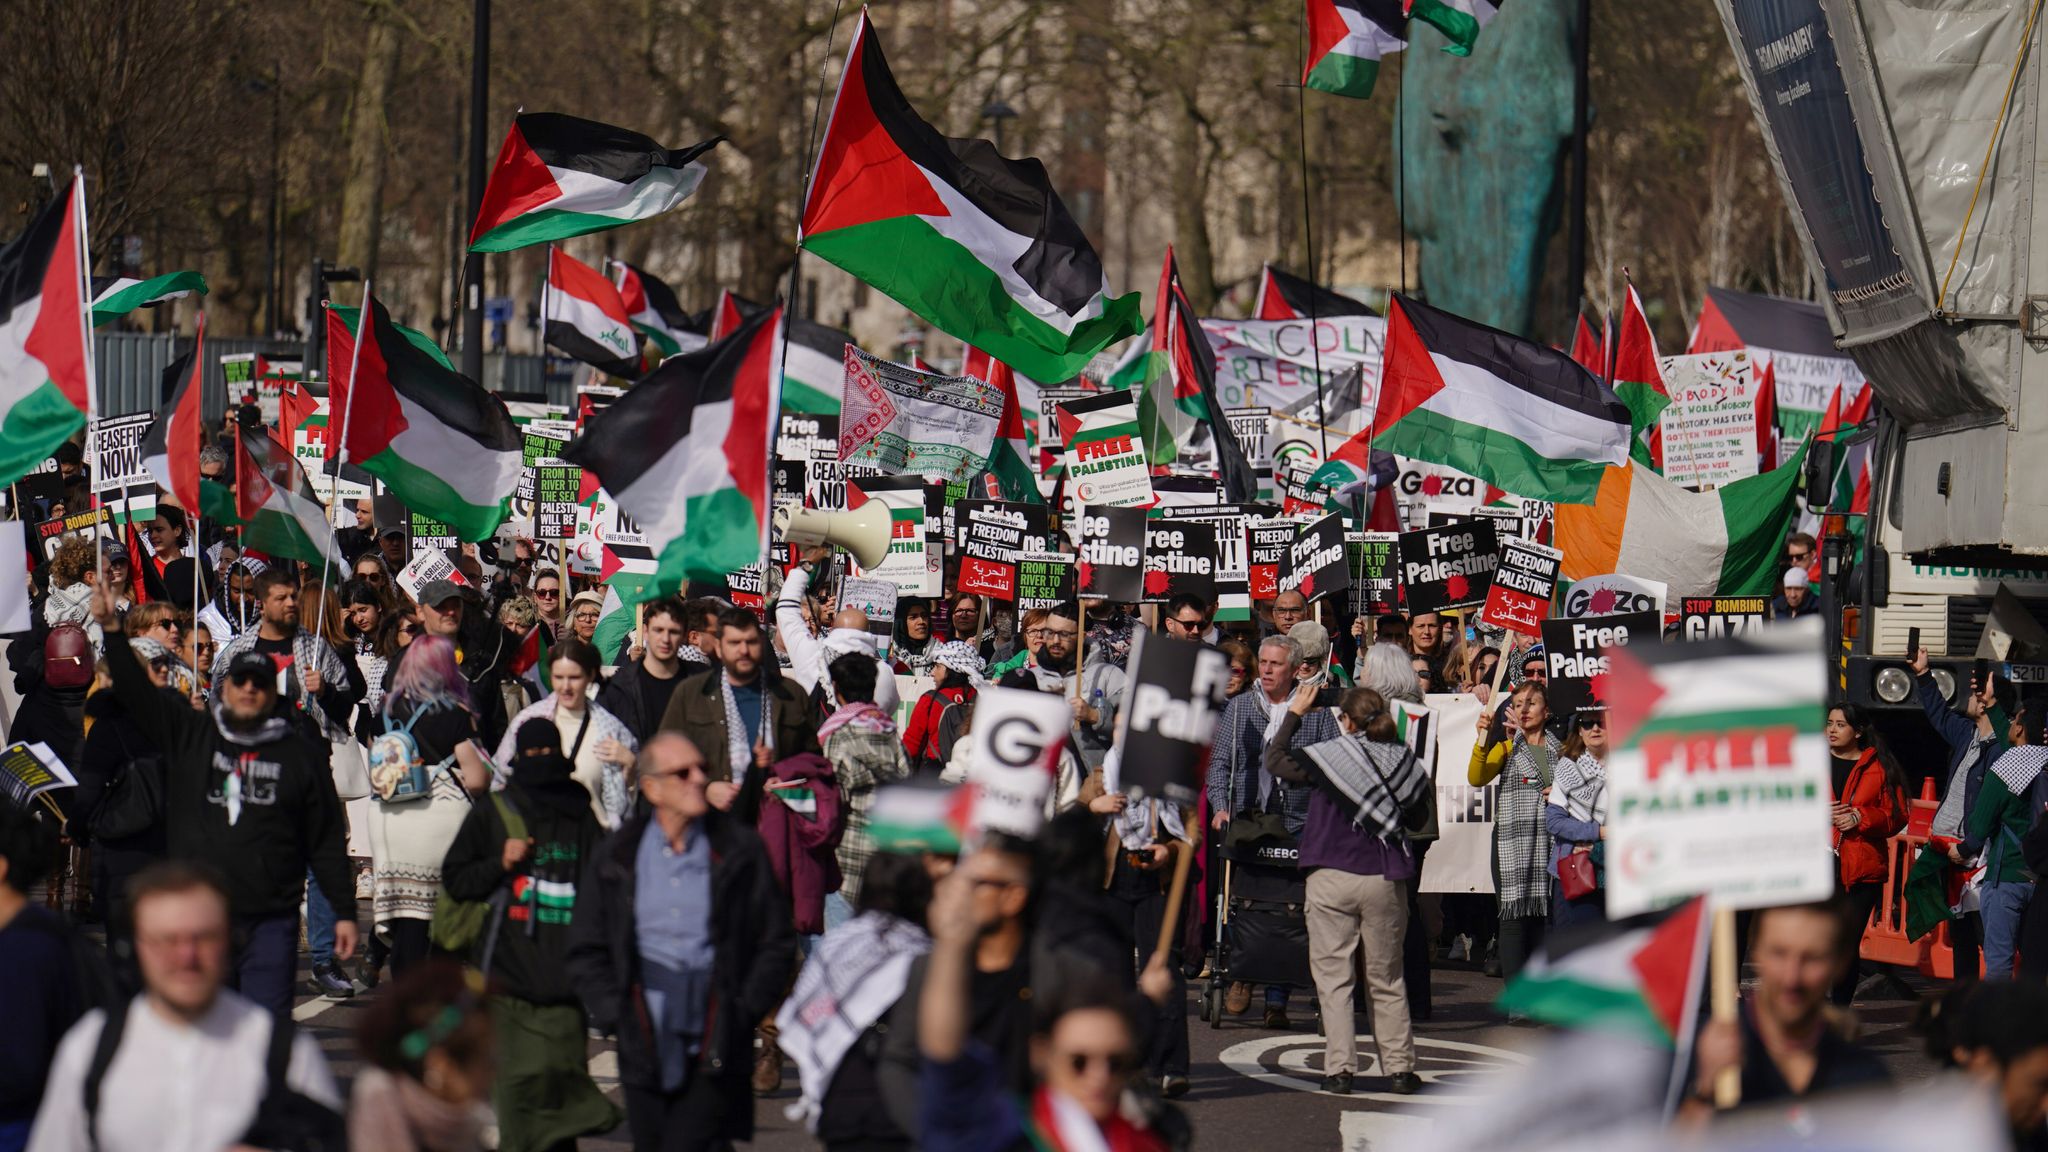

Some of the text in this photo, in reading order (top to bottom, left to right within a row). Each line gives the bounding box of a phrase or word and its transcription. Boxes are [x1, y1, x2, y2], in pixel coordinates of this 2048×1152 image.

[1203, 321, 1385, 357] INCOLN
[1216, 357, 1374, 402] FRIENS
[1674, 386, 1744, 402] OBODY IN
[782, 416, 819, 434] Free
[1231, 418, 1269, 435] SEFIRE
[1714, 416, 1730, 424] HAS
[1732, 414, 1753, 422] EVER
[525, 435, 563, 451] FROM THE
[1075, 434, 1133, 462] FREE
[524, 446, 557, 458] RIVER TO
[523, 456, 535, 467] THE
[1071, 454, 1144, 478] PALESTINE
[541, 468, 565, 478] FROM
[520, 478, 535, 490] WILL
[541, 480, 580, 490] RIVER TO
[517, 488, 534, 499] FREE
[541, 491, 576, 502] THE SEA
[819, 482, 845, 508] NO
[40, 510, 108, 537] STOP BOMBIG
[541, 514, 574, 524] WILL BE
[978, 514, 1018, 526] Socialist Worker
[1083, 516, 1110, 537] ee
[412, 525, 447, 536] THE SEA
[541, 526, 560, 536] FREE
[892, 520, 915, 538] EE
[972, 522, 1020, 544] FREEDOM
[605, 533, 642, 543] FREE PALESTINE
[1147, 530, 1184, 548] ree
[1427, 532, 1474, 556] Free
[888, 542, 923, 554] STINE
[1082, 539, 1139, 566] stine
[1253, 550, 1282, 562] PALES
[1291, 532, 1320, 566] Free
[1374, 543, 1390, 554] THE
[1513, 540, 1554, 556] Socialist Worker
[1021, 562, 1066, 575] FROM THE
[1144, 551, 1210, 574] estine
[1374, 555, 1386, 566] TO
[1406, 552, 1499, 585] Palestine
[1504, 549, 1554, 576] FREEDOM
[412, 558, 446, 591] END ISRAELI
[972, 562, 1006, 577] الحرية
[1368, 567, 1382, 578] SEA
[966, 575, 1008, 591] لفلسطين
[1021, 574, 1060, 587] RIVER TO
[1496, 569, 1552, 598] PALESTINE
[1020, 586, 1056, 598] THE SEA
[1370, 590, 1382, 602] BE
[1501, 592, 1536, 611] الحرية
[1686, 600, 1764, 613] STOP BOMBING
[1491, 607, 1538, 627] لفلسطين
[1686, 614, 1764, 643] GAZA
[1572, 624, 1628, 650] Free
[1550, 652, 1612, 678] Pales
[1640, 725, 1797, 782] FREE
